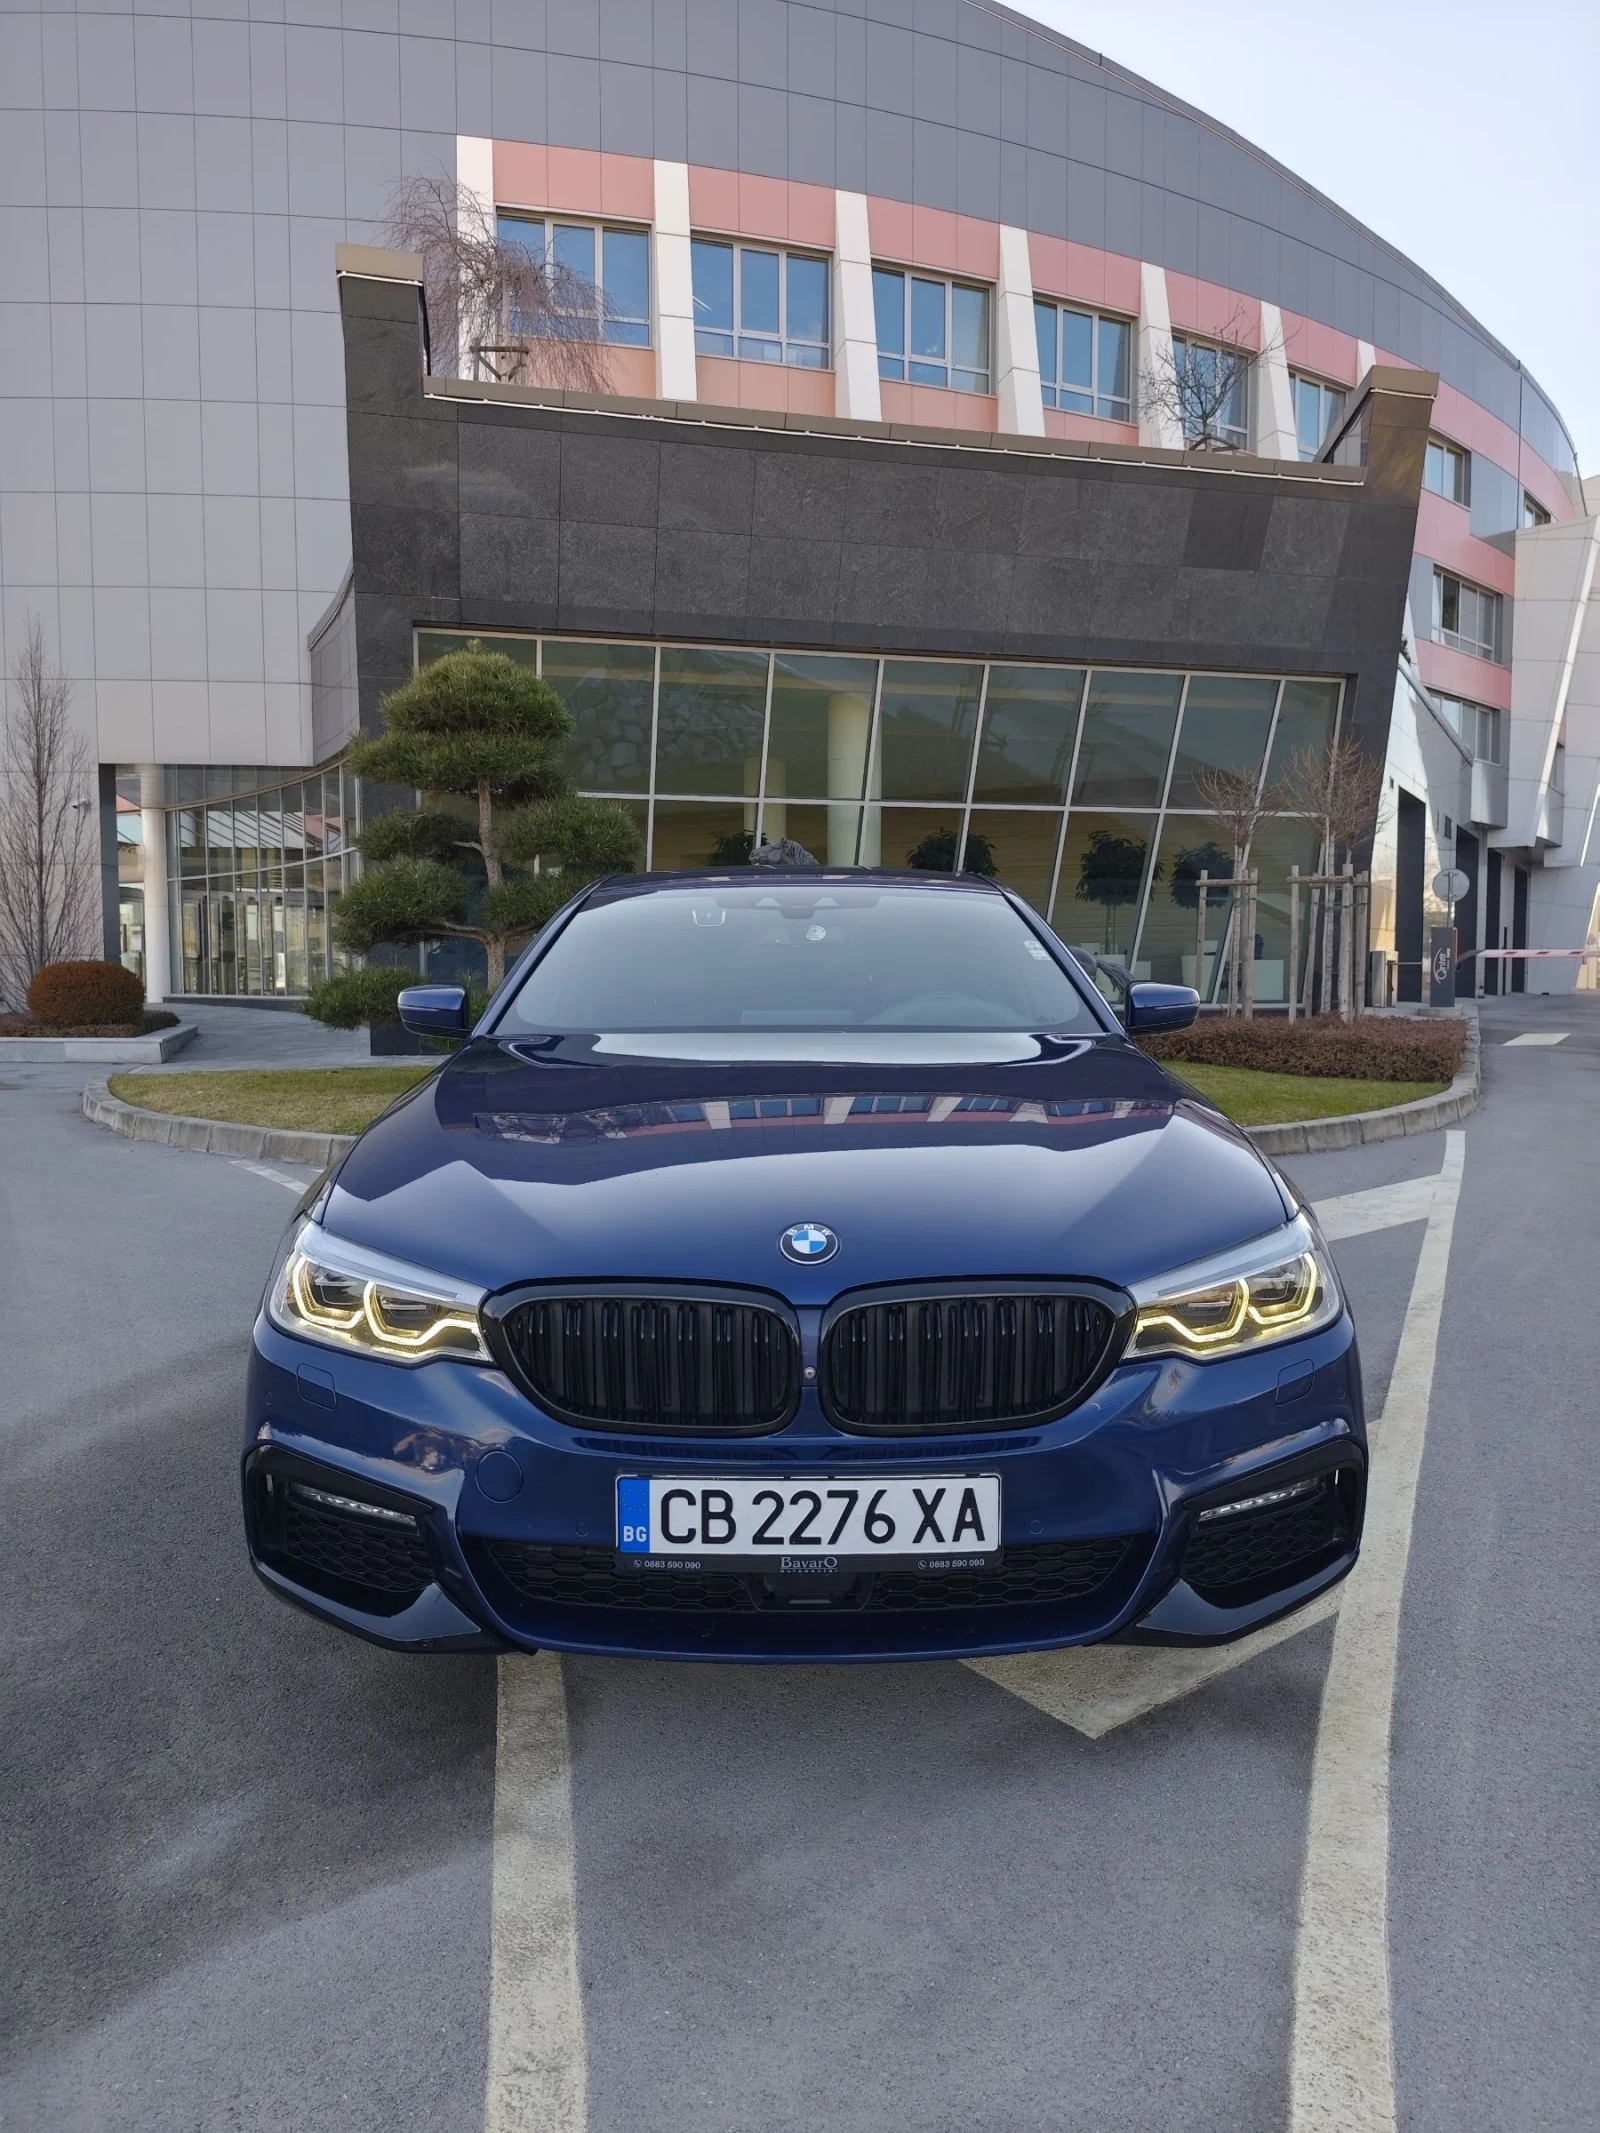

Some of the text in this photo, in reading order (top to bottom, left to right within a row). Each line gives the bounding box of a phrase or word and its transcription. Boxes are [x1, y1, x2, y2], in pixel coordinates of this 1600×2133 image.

[787, 1224, 832, 1236] BMW
[661, 1487, 986, 1545] CB 2276 XA
[623, 1526, 647, 1543] BG
[644, 1560, 701, 1569] 0883 590 090
[929, 1558, 985, 1569] 0883 590 090
